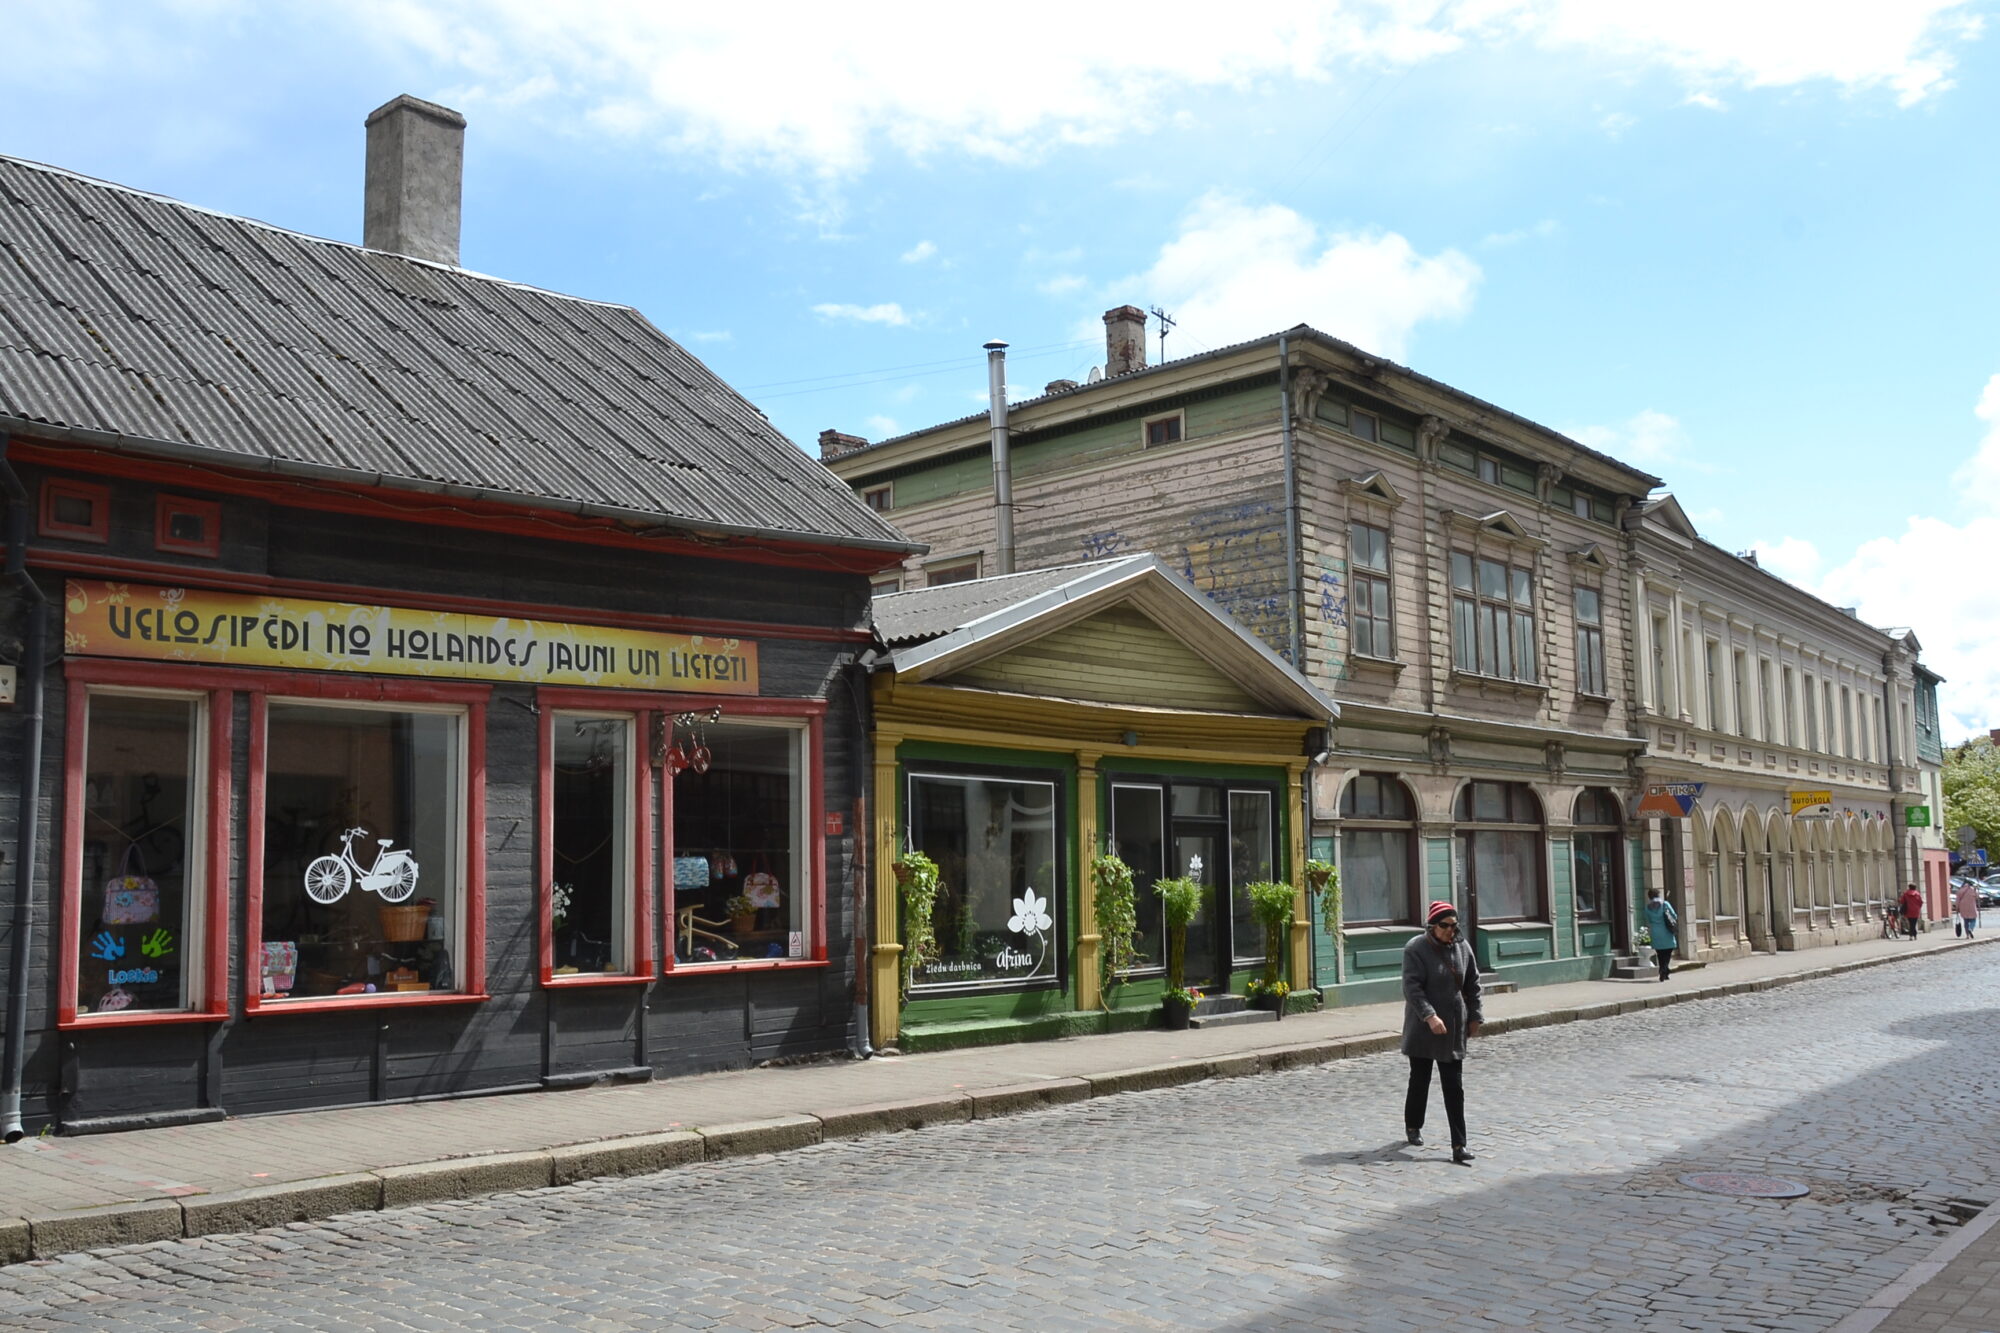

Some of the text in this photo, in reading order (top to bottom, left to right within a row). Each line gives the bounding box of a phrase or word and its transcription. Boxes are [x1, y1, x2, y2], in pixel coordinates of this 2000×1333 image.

[326, 623, 371, 656] NO
[387, 628, 538, 668] HOLANDES
[547, 641, 616, 675] JAUNI
[628, 647, 660, 677] UN
[672, 653, 747, 682] LIETOTI
[1649, 784, 1698, 797] OPTIKA
